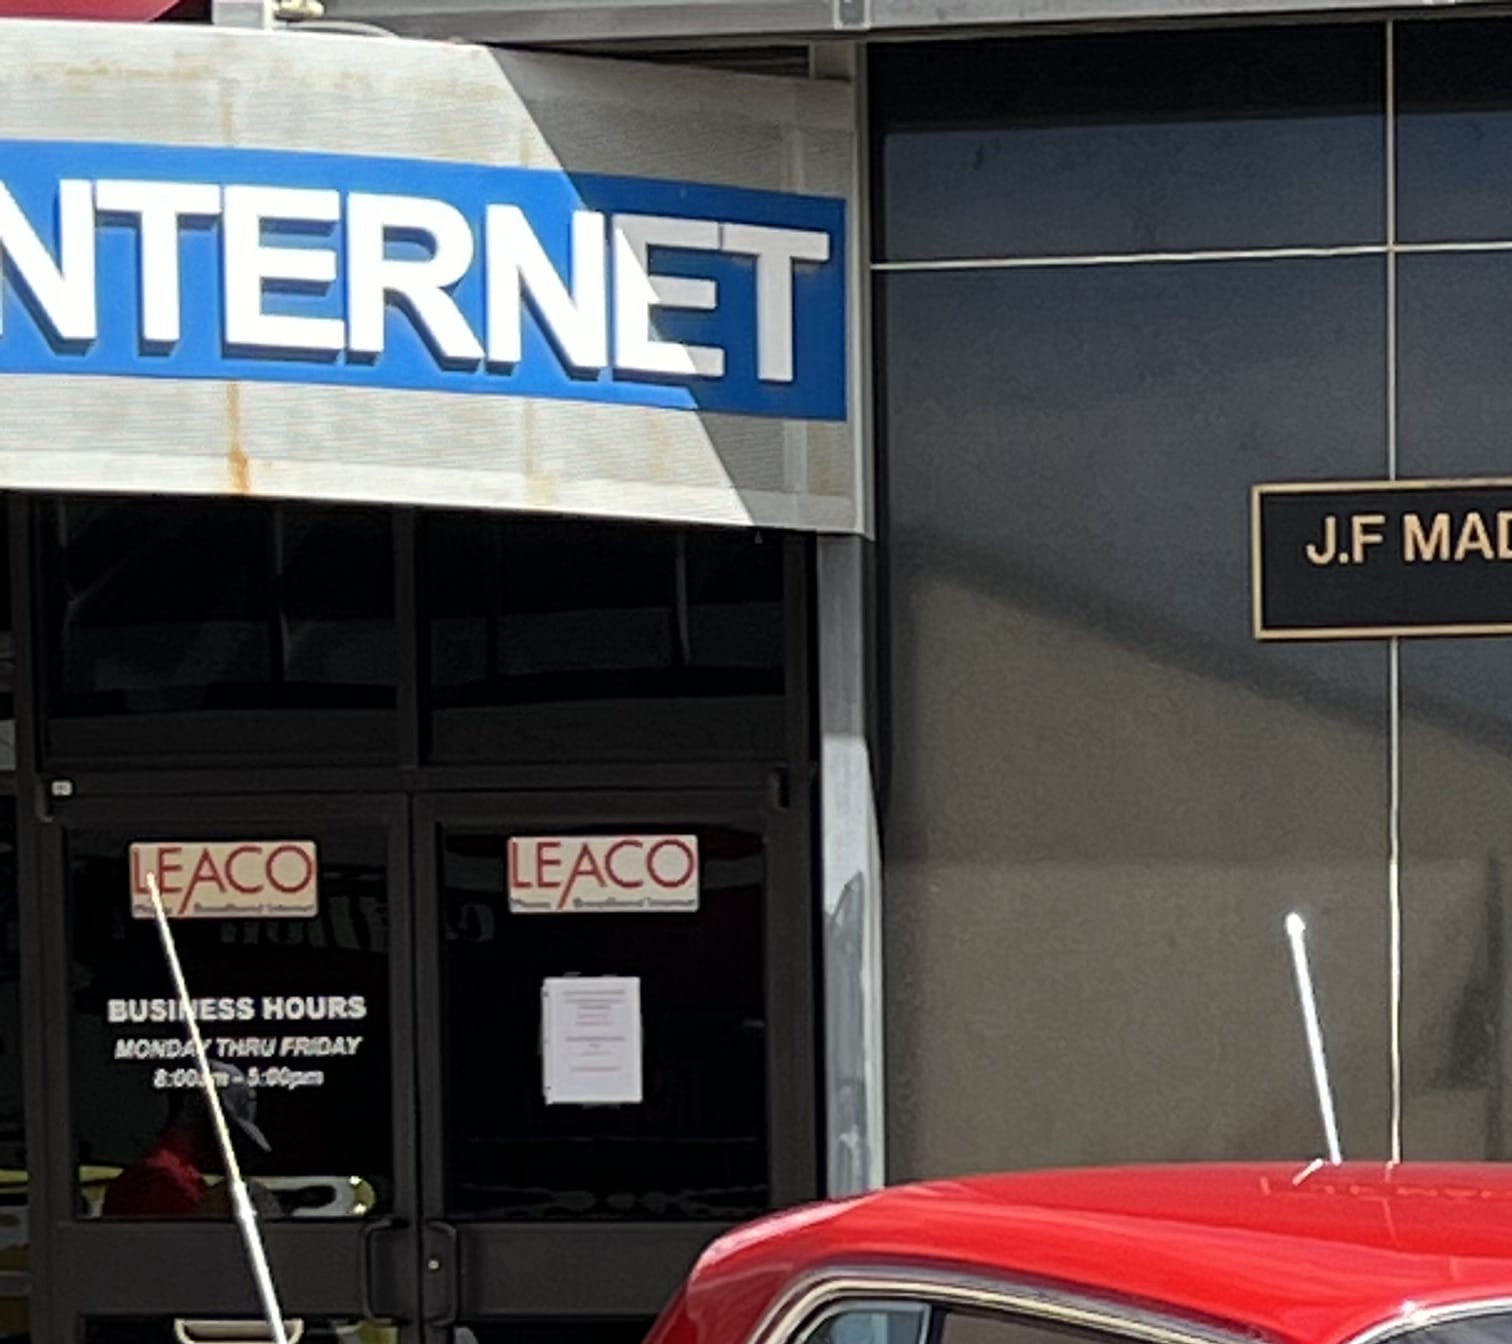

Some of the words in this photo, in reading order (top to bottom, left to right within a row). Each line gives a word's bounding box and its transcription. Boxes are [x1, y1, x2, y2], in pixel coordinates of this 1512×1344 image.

[1305, 514, 1385, 564] J.F
[133, 845, 313, 915] LEACO
[512, 839, 695, 911] LEACO
[107, 997, 255, 1022] BUSINESS
[261, 996, 367, 1020] HOURS
[216, 1037, 277, 1057] THRU
[279, 1036, 363, 1056] FRIDAY
[247, 1066, 325, 1090] 5:00pm
